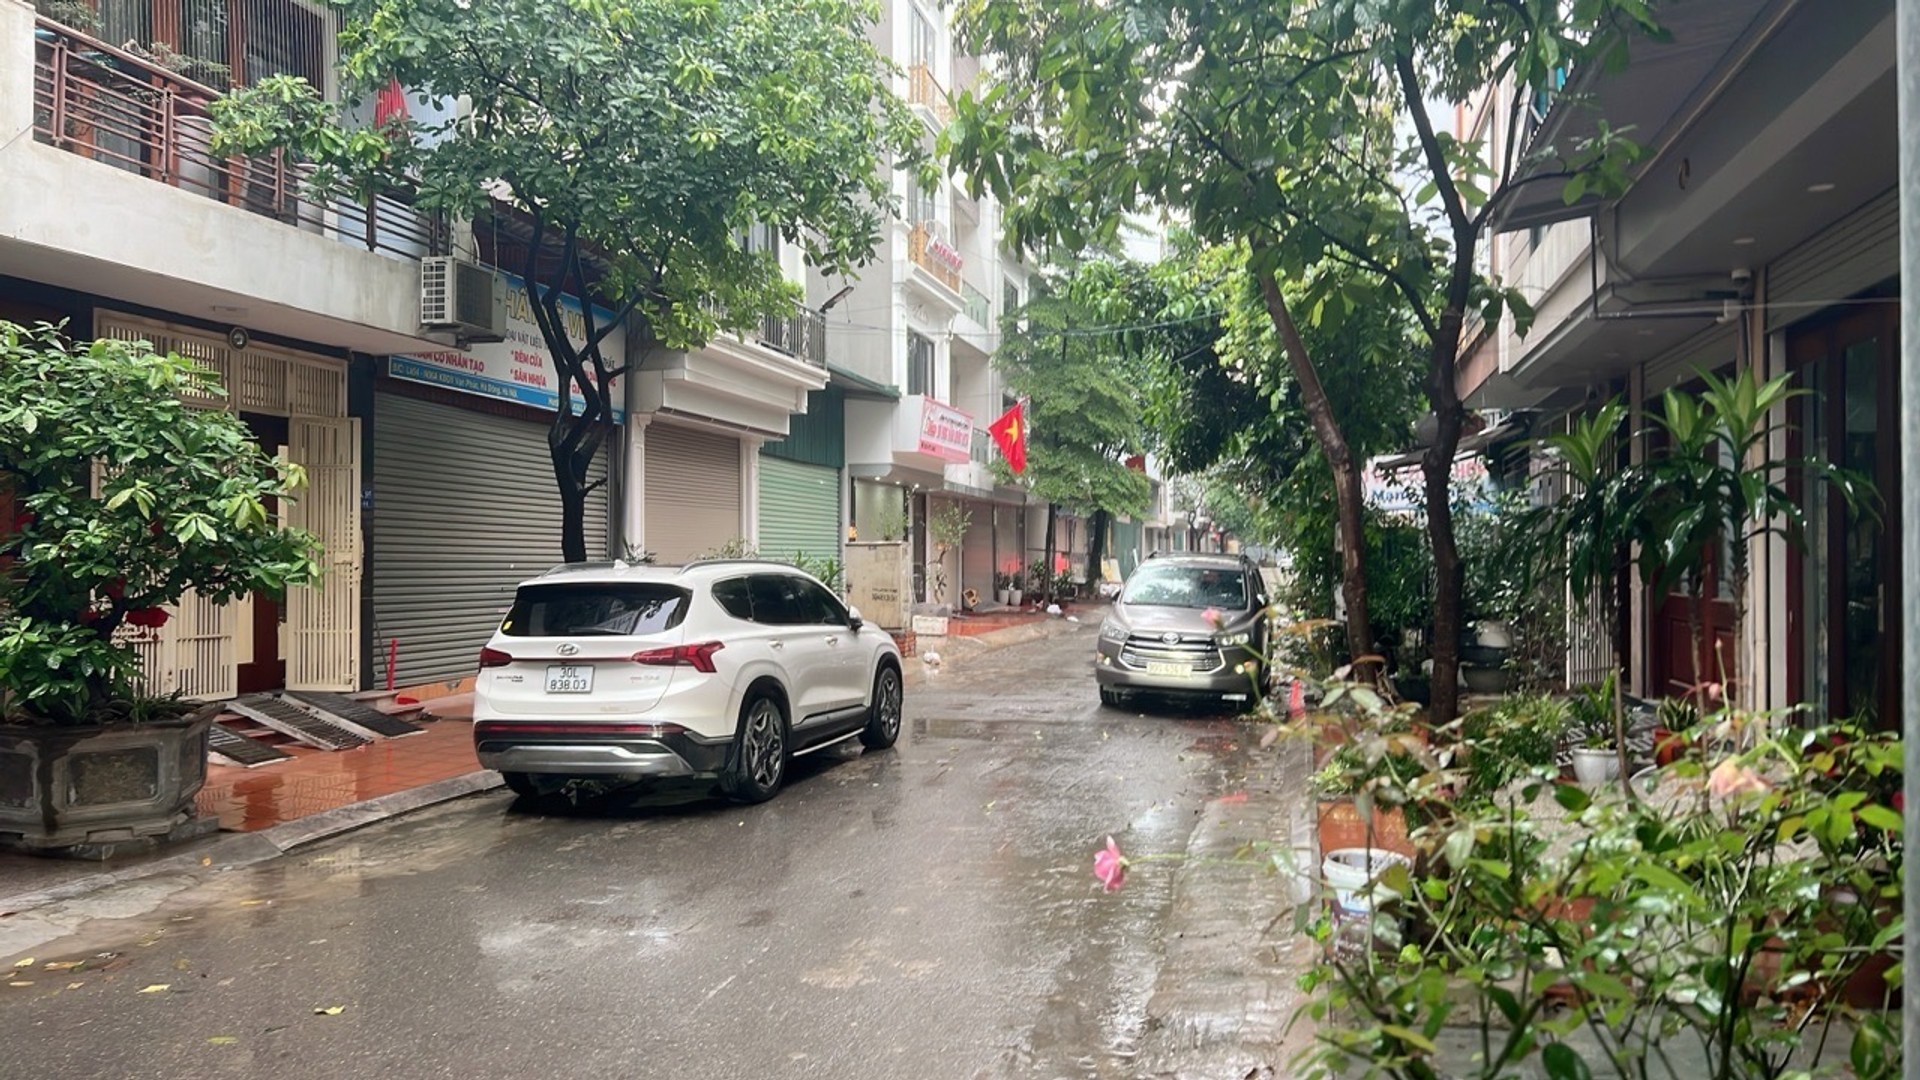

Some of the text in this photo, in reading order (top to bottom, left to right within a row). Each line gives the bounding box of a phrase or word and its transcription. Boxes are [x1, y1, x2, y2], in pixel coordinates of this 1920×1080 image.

[469, 360, 485, 376] TẠO
[560, 667, 579, 678] 30L
[550, 679, 587, 690] 838.03
